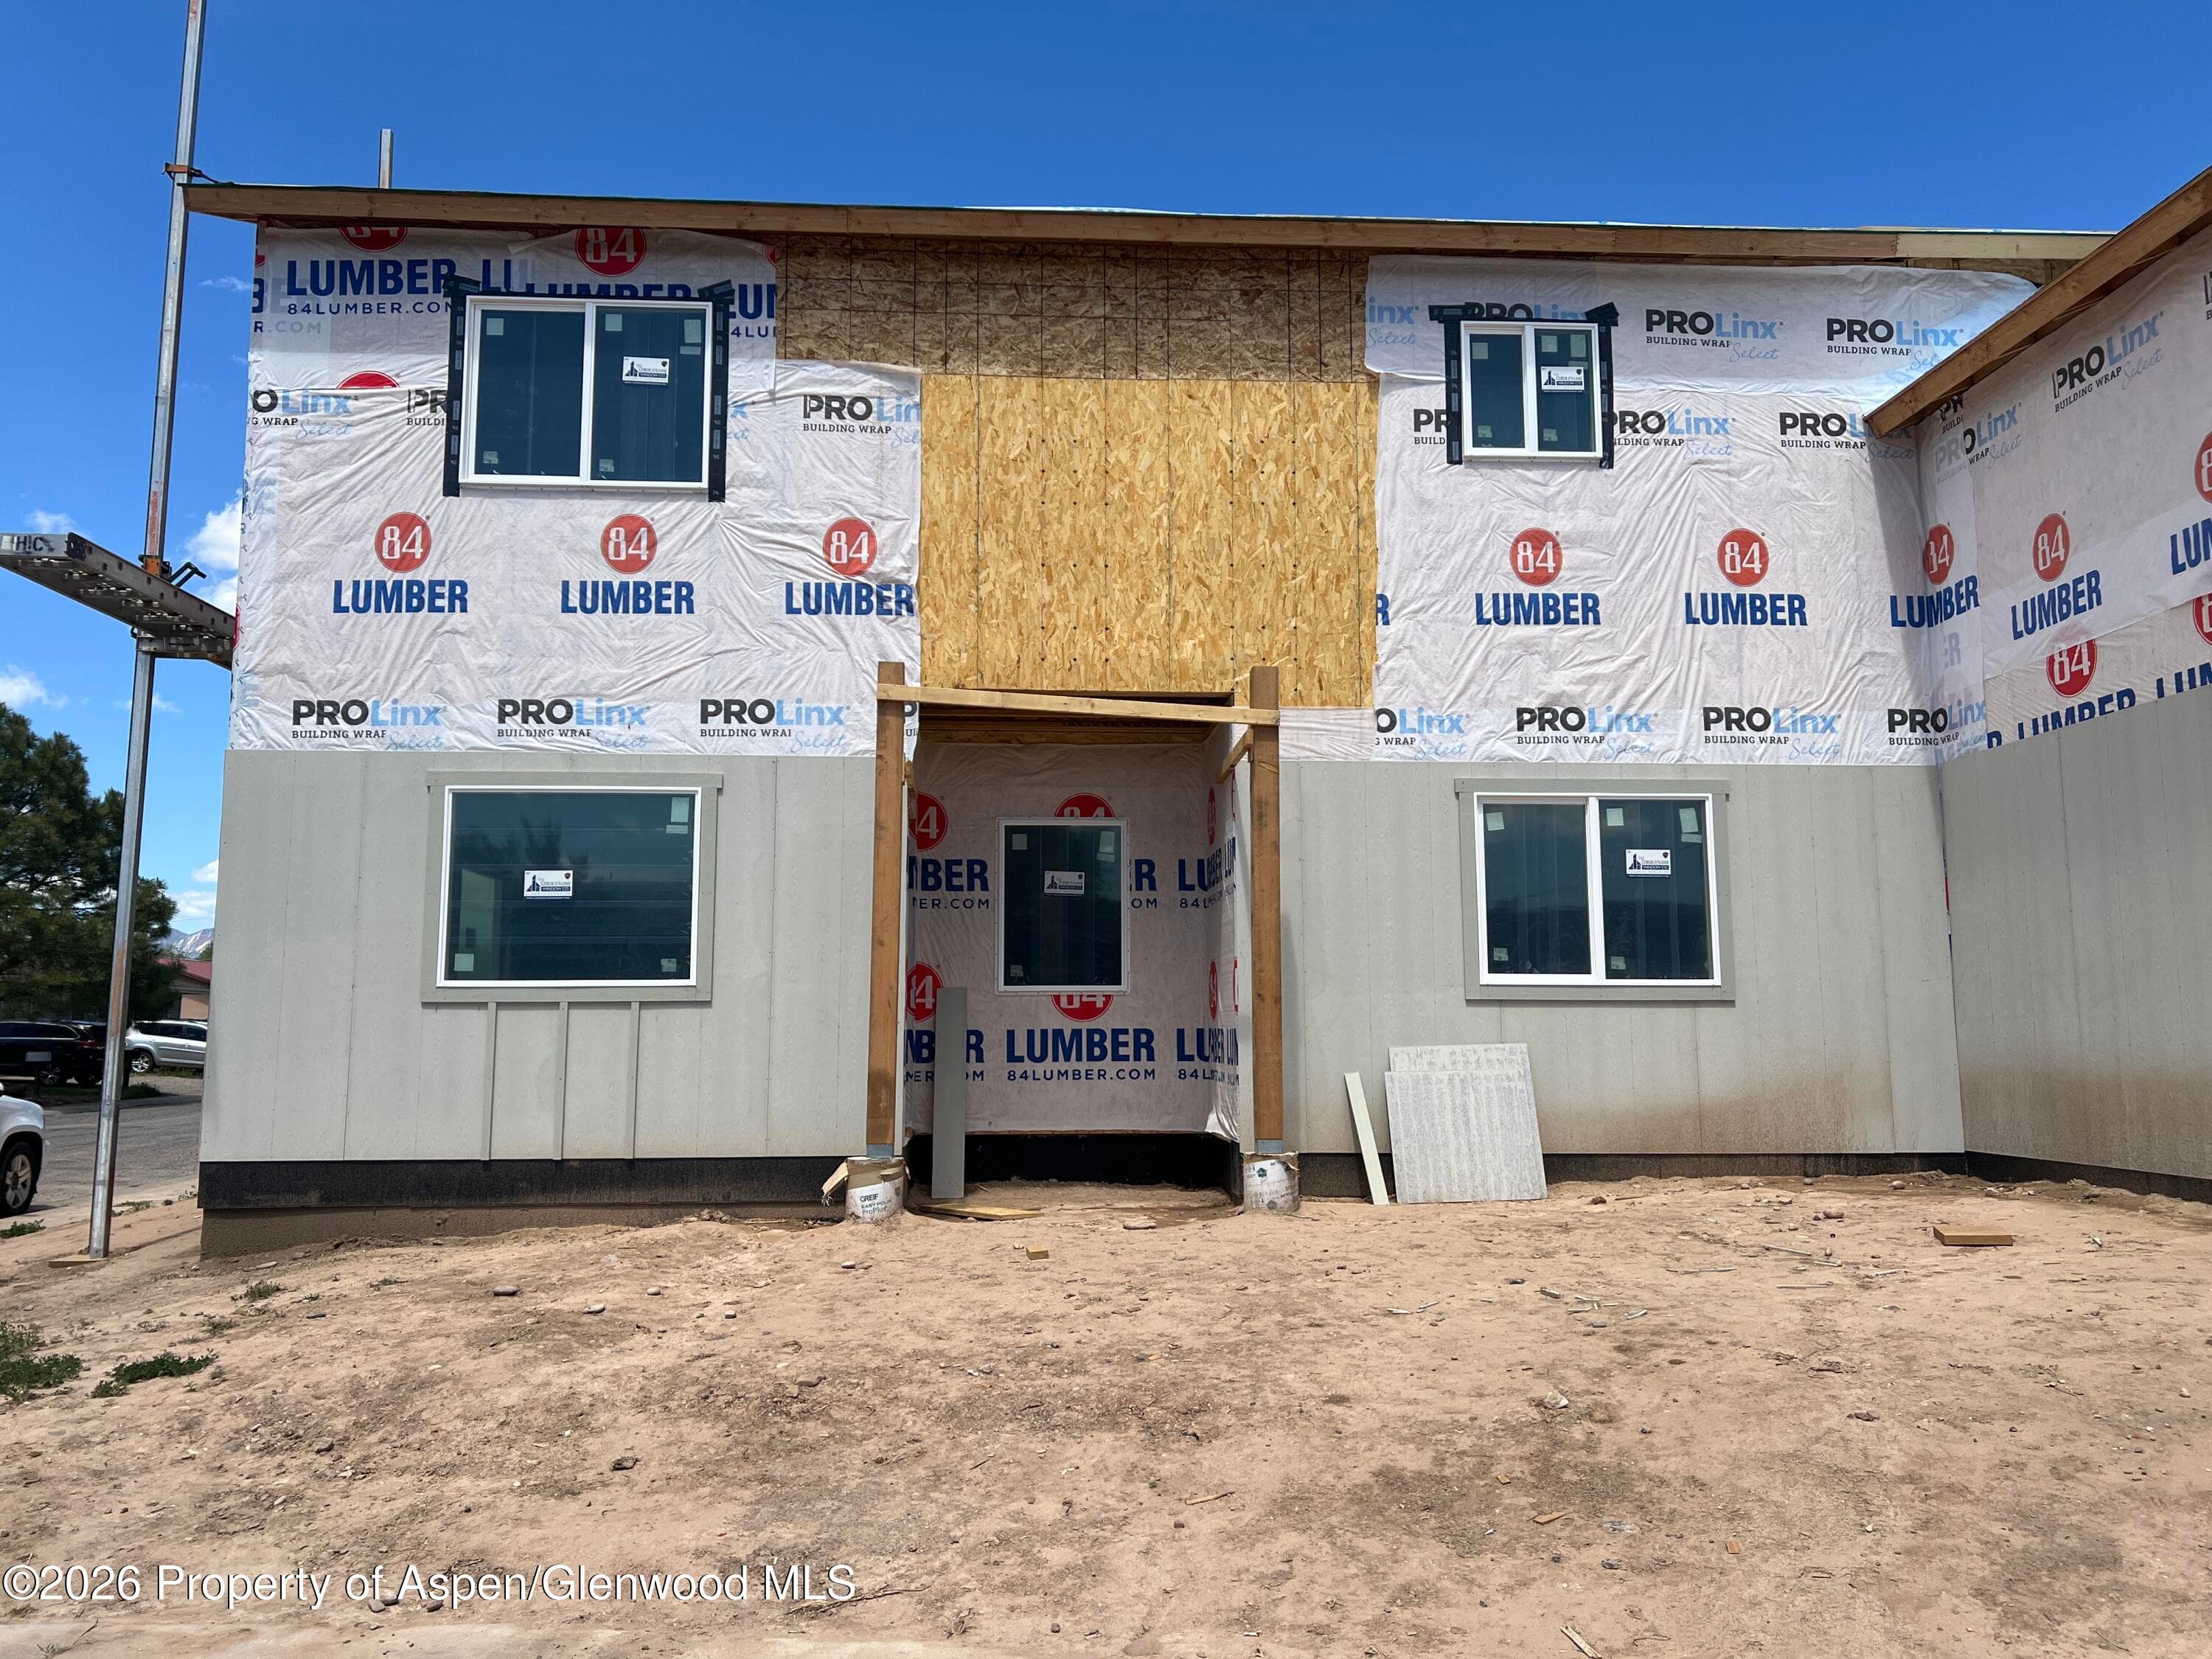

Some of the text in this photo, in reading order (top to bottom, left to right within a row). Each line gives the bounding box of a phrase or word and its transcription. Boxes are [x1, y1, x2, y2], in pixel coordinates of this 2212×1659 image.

[585, 229, 637, 264] 84
[1366, 327, 1416, 348] Select
[1646, 309, 1778, 340] PROLinx
[1826, 318, 1958, 347] PROLinx
[1646, 335, 1732, 348] BUILDING WRAP
[1729, 343, 1779, 362] Select
[1827, 345, 1911, 356] BUILDING WRAP
[2052, 316, 2160, 399] PROLinx
[2122, 348, 2164, 390] Select
[2055, 366, 2122, 413] BUILDING WRAP
[263, 417, 298, 425] WRAP
[296, 418, 353, 439] Select
[803, 423, 891, 434] BUILDING WRAP
[1654, 438, 1684, 446] WRAP
[1683, 438, 1733, 460] Select
[1781, 440, 1866, 449] BUILDING WRAP
[1969, 448, 1989, 465] WRAP
[382, 525, 423, 559] 84
[608, 526, 650, 560] 84
[830, 530, 869, 564] 84
[2038, 524, 2065, 571] 84
[1517, 541, 1556, 573] 84
[1724, 542, 1762, 574] 84
[333, 579, 468, 613] LUMBER
[561, 580, 695, 614] LUMBER
[785, 582, 915, 616] LUMBER
[1475, 593, 1601, 626] LUMBER
[1684, 593, 1808, 626] LUMBER
[1890, 575, 1980, 627] LUMBER
[2011, 570, 2103, 641] LUMBER
[292, 698, 442, 726] PROLinx
[498, 698, 646, 726] PROLinx
[700, 698, 846, 726] PROLinx
[1517, 706, 1653, 733] PROLinx
[1703, 706, 1839, 734] PROLinx
[1888, 700, 1986, 734] PROLinx
[292, 730, 349, 738] BUILDING
[497, 728, 554, 737] BUILDING
[700, 728, 757, 737] BUILDING
[790, 731, 846, 753] Select
[1517, 736, 1605, 745] BUILDING WRAP
[1704, 736, 1789, 745] BUILDING WRAP
[1889, 732, 1959, 745] BUILDING WRAP
[1415, 739, 1467, 759] Select
[1604, 738, 1654, 759] Select
[1788, 739, 1840, 759] Select
[1006, 1028, 1155, 1063] LUMBER
[1007, 1068, 1156, 1082] 84LUMBER.COM
